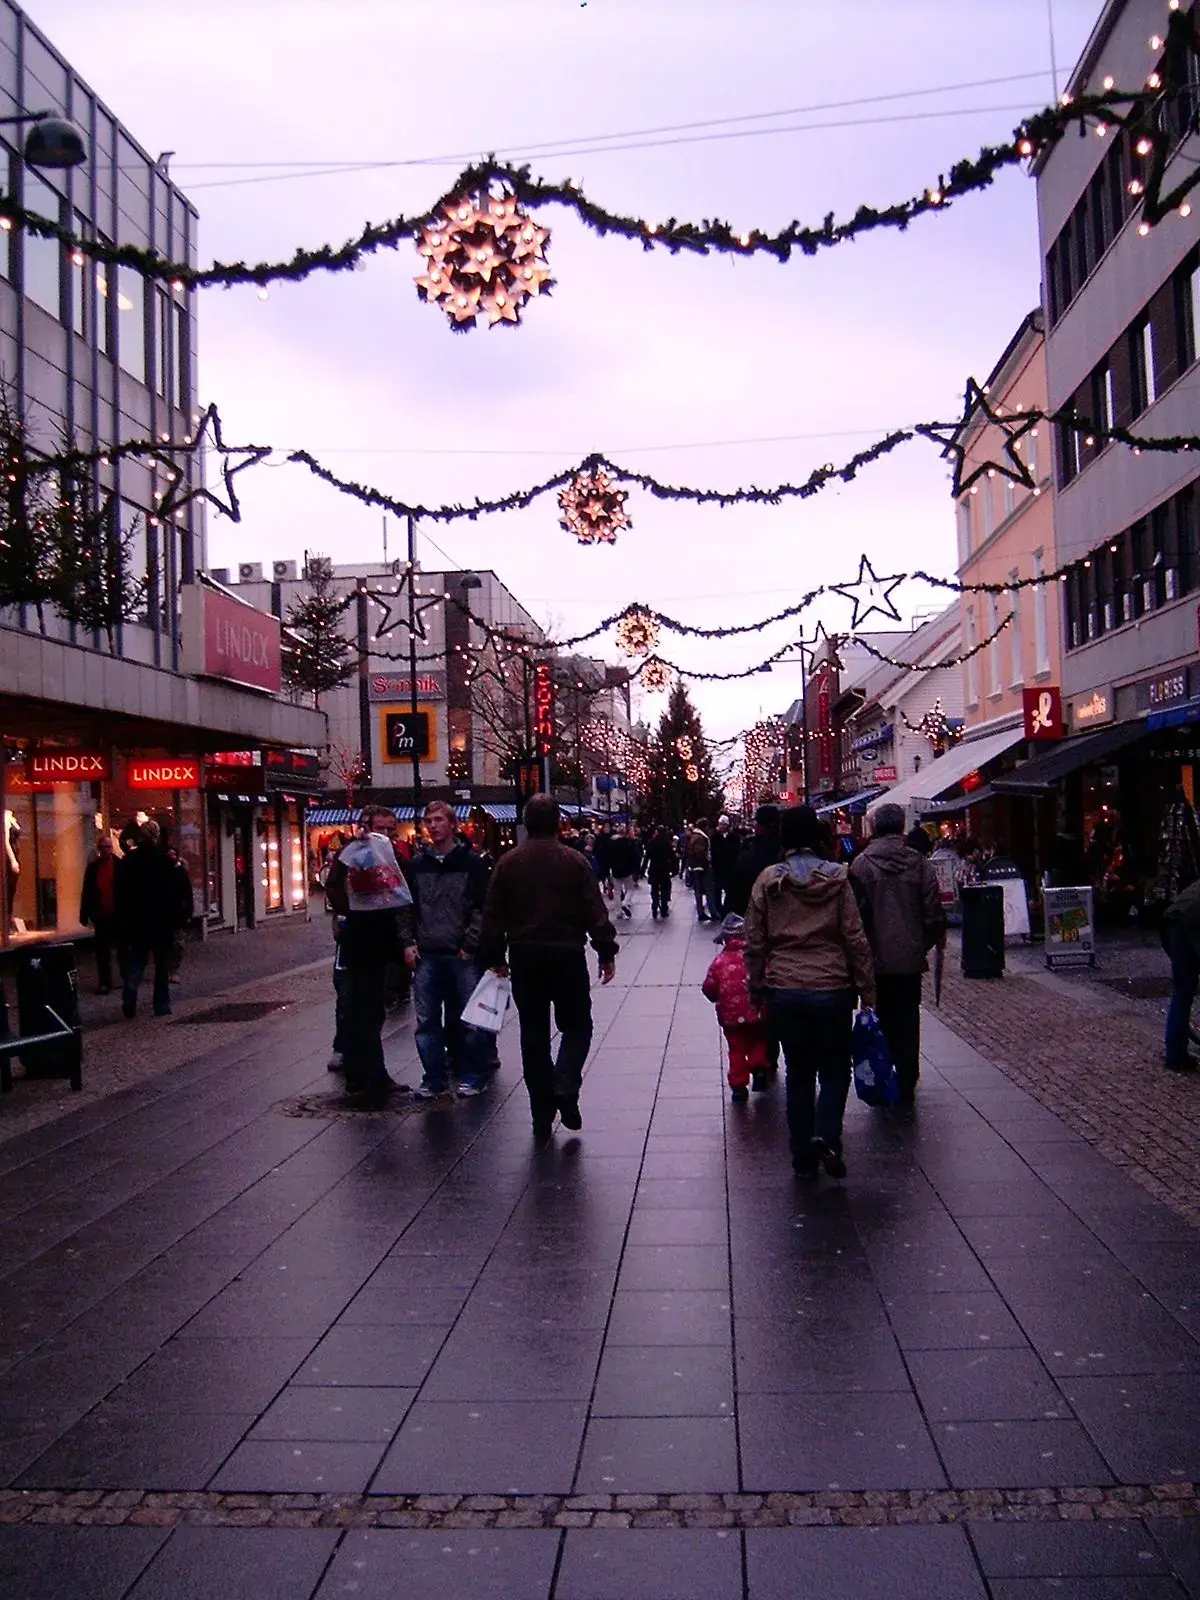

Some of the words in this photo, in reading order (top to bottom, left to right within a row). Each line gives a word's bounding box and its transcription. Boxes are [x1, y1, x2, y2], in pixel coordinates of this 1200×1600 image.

[216, 616, 270, 670] LINDEX
[33, 756, 103, 771] LINDEX
[133, 767, 194, 781] LINDEX
